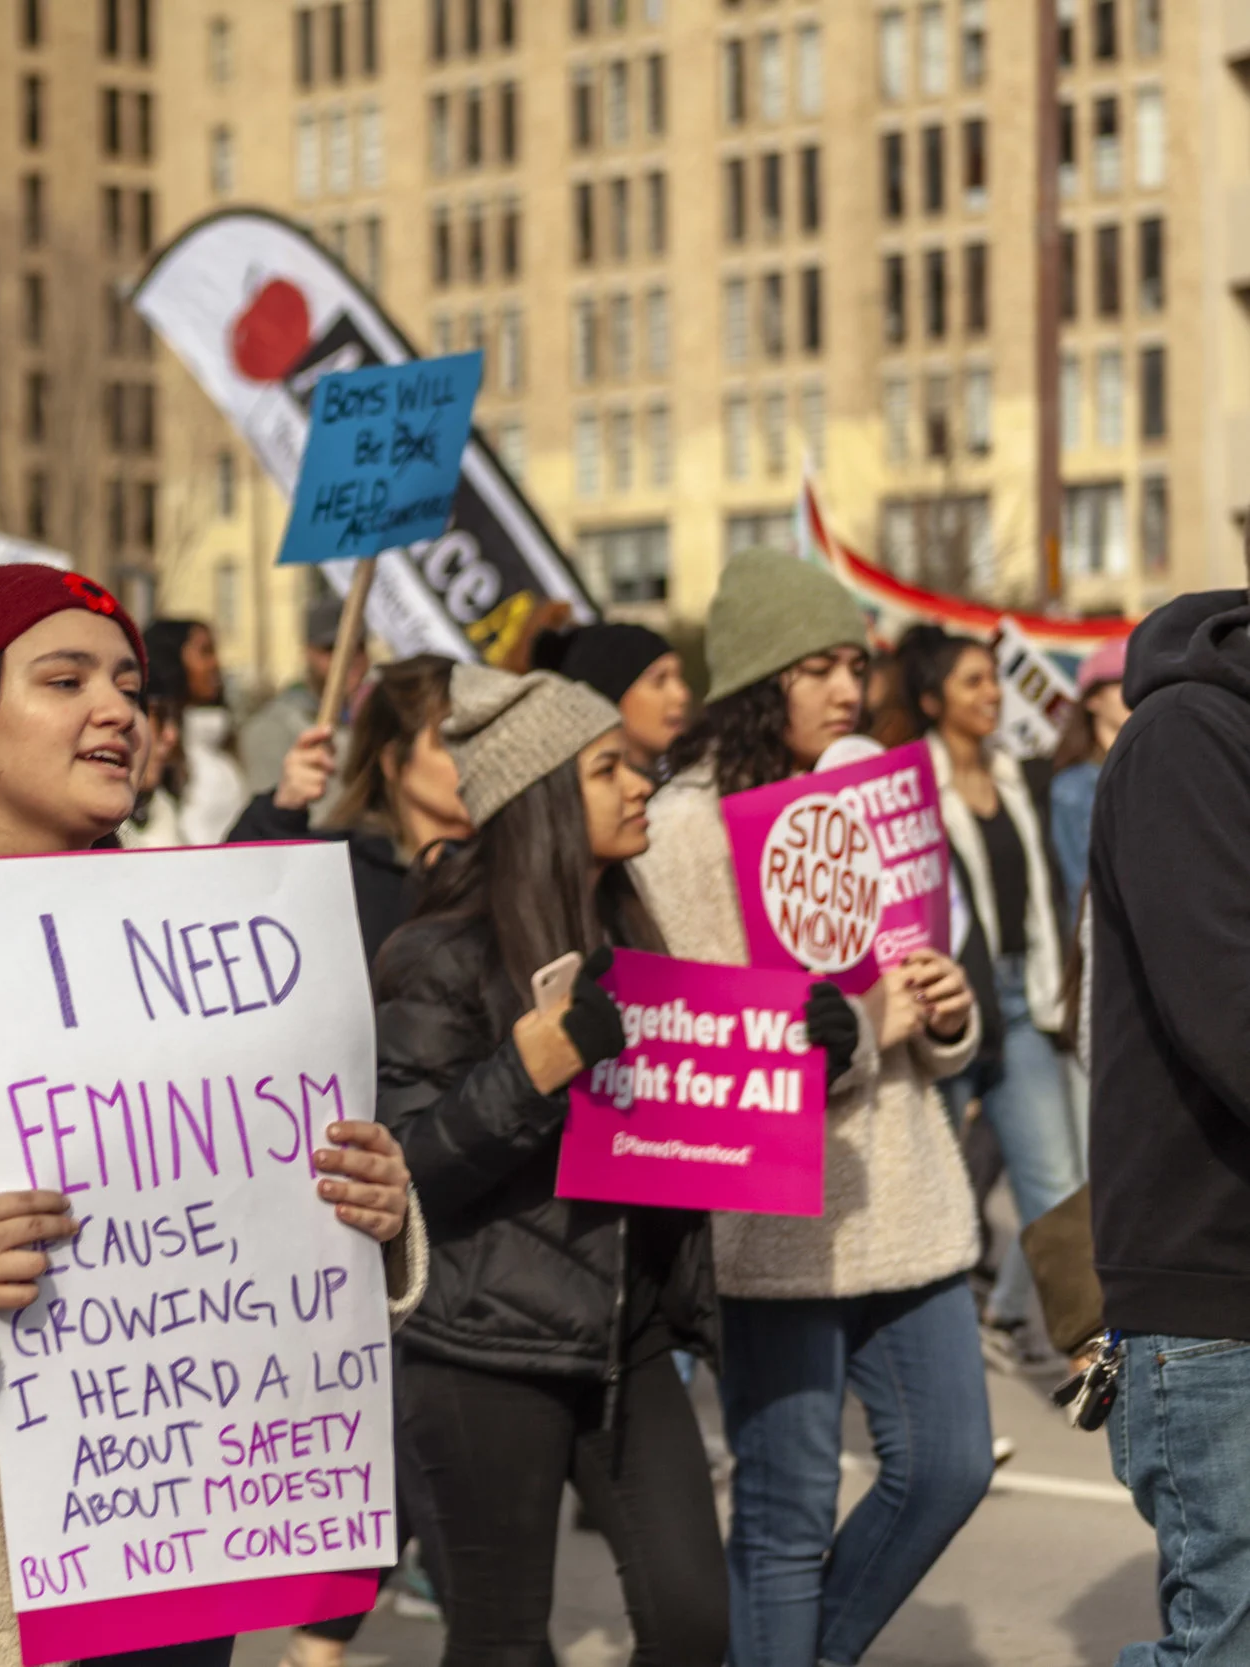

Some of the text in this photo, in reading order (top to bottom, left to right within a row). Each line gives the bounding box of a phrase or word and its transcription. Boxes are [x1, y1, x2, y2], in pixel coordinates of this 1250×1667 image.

[396, 372, 456, 412] WILL
[310, 477, 389, 526] HELD
[784, 803, 869, 865] STOP
[874, 804, 942, 861] LEGAL
[765, 846, 880, 923] RACISM
[777, 899, 868, 965] NOW
[38, 913, 302, 1029] I NEED
[740, 1007, 813, 1056] We
[674, 1058, 736, 1108] for
[736, 1067, 804, 1115] All
[6, 1071, 350, 1196] FEMINISM
[10, 1266, 350, 1359] GROWING UP
[8, 1341, 388, 1432] I HEARD A LOT
[72, 1408, 363, 1487] ABOUT SAFETY
[61, 1461, 374, 1535] ABOUT MODESTY
[18, 1508, 393, 1602] BUT NOT CONSENT
